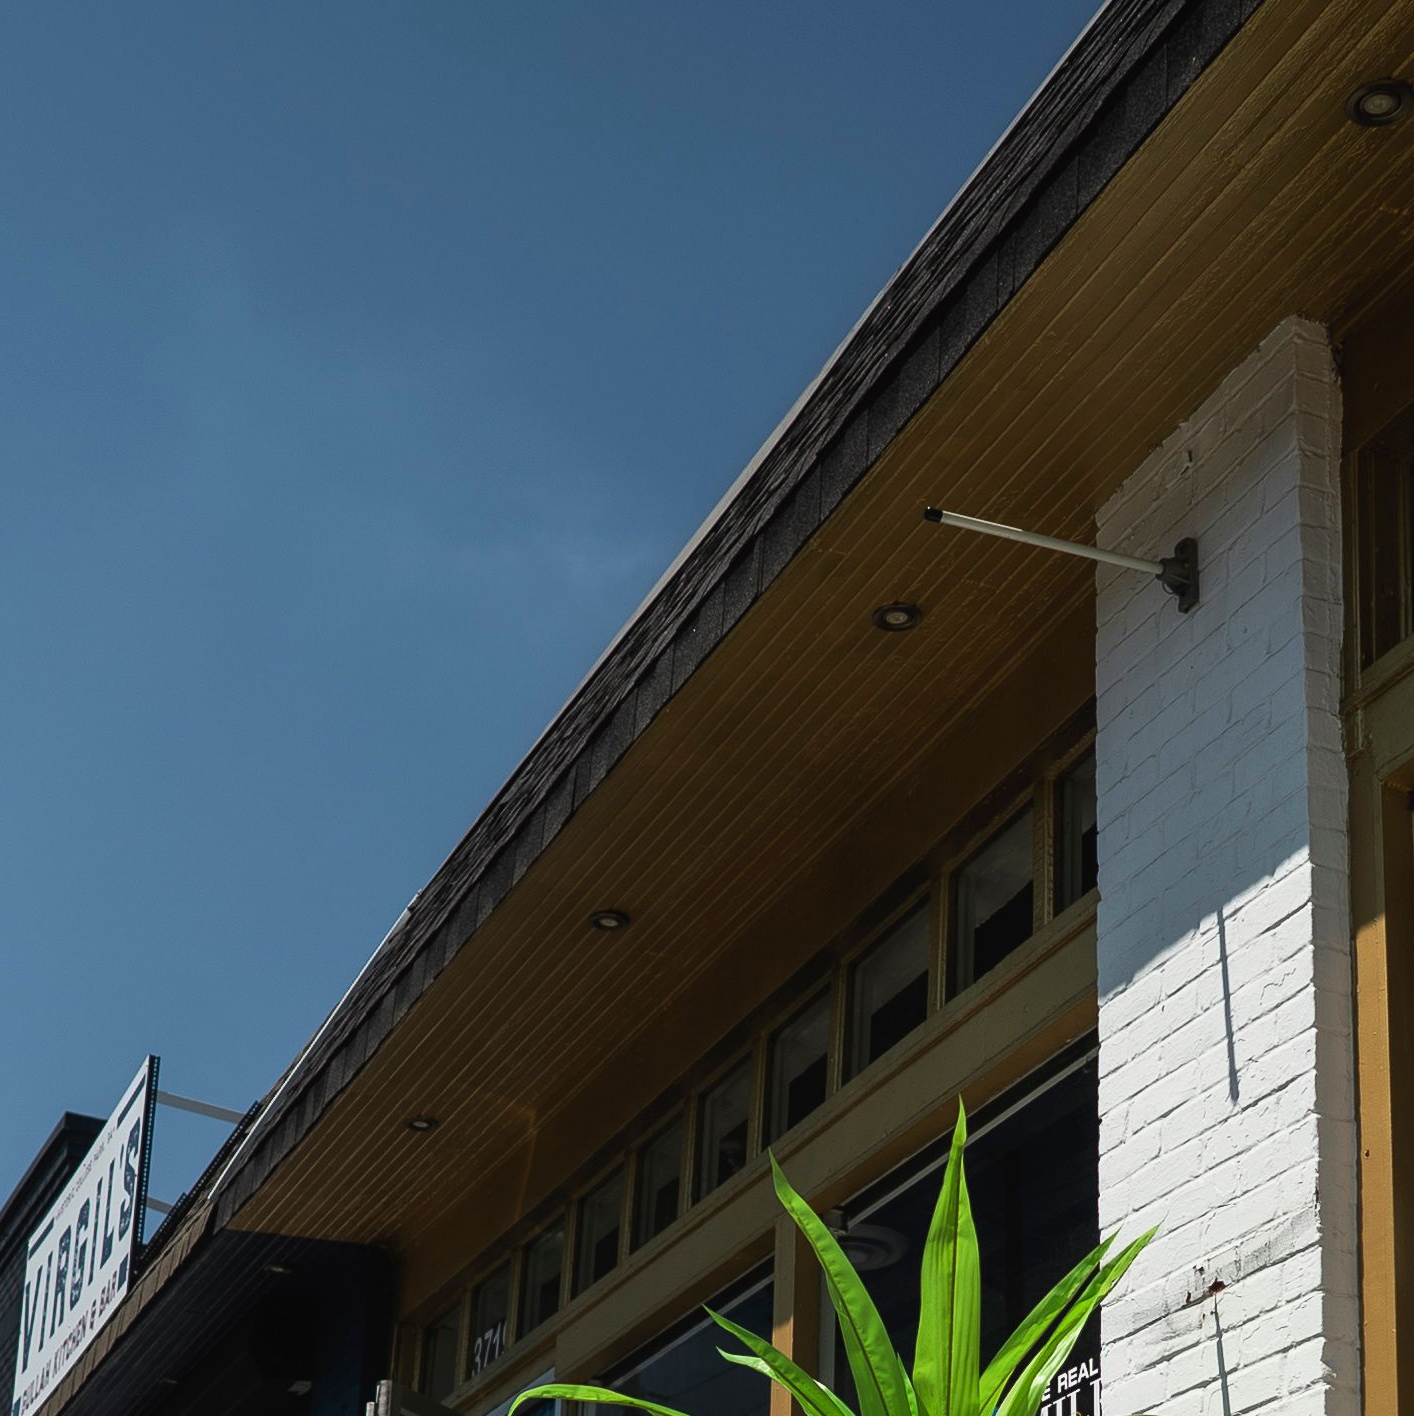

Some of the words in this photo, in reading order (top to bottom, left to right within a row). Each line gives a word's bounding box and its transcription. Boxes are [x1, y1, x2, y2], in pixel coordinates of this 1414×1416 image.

[21, 1116, 142, 1375] VIRGIL'S
[52, 1309, 89, 1379] KITCHEN
[99, 1270, 118, 1318] BAR
[1057, 1357, 1099, 1393] REAL
